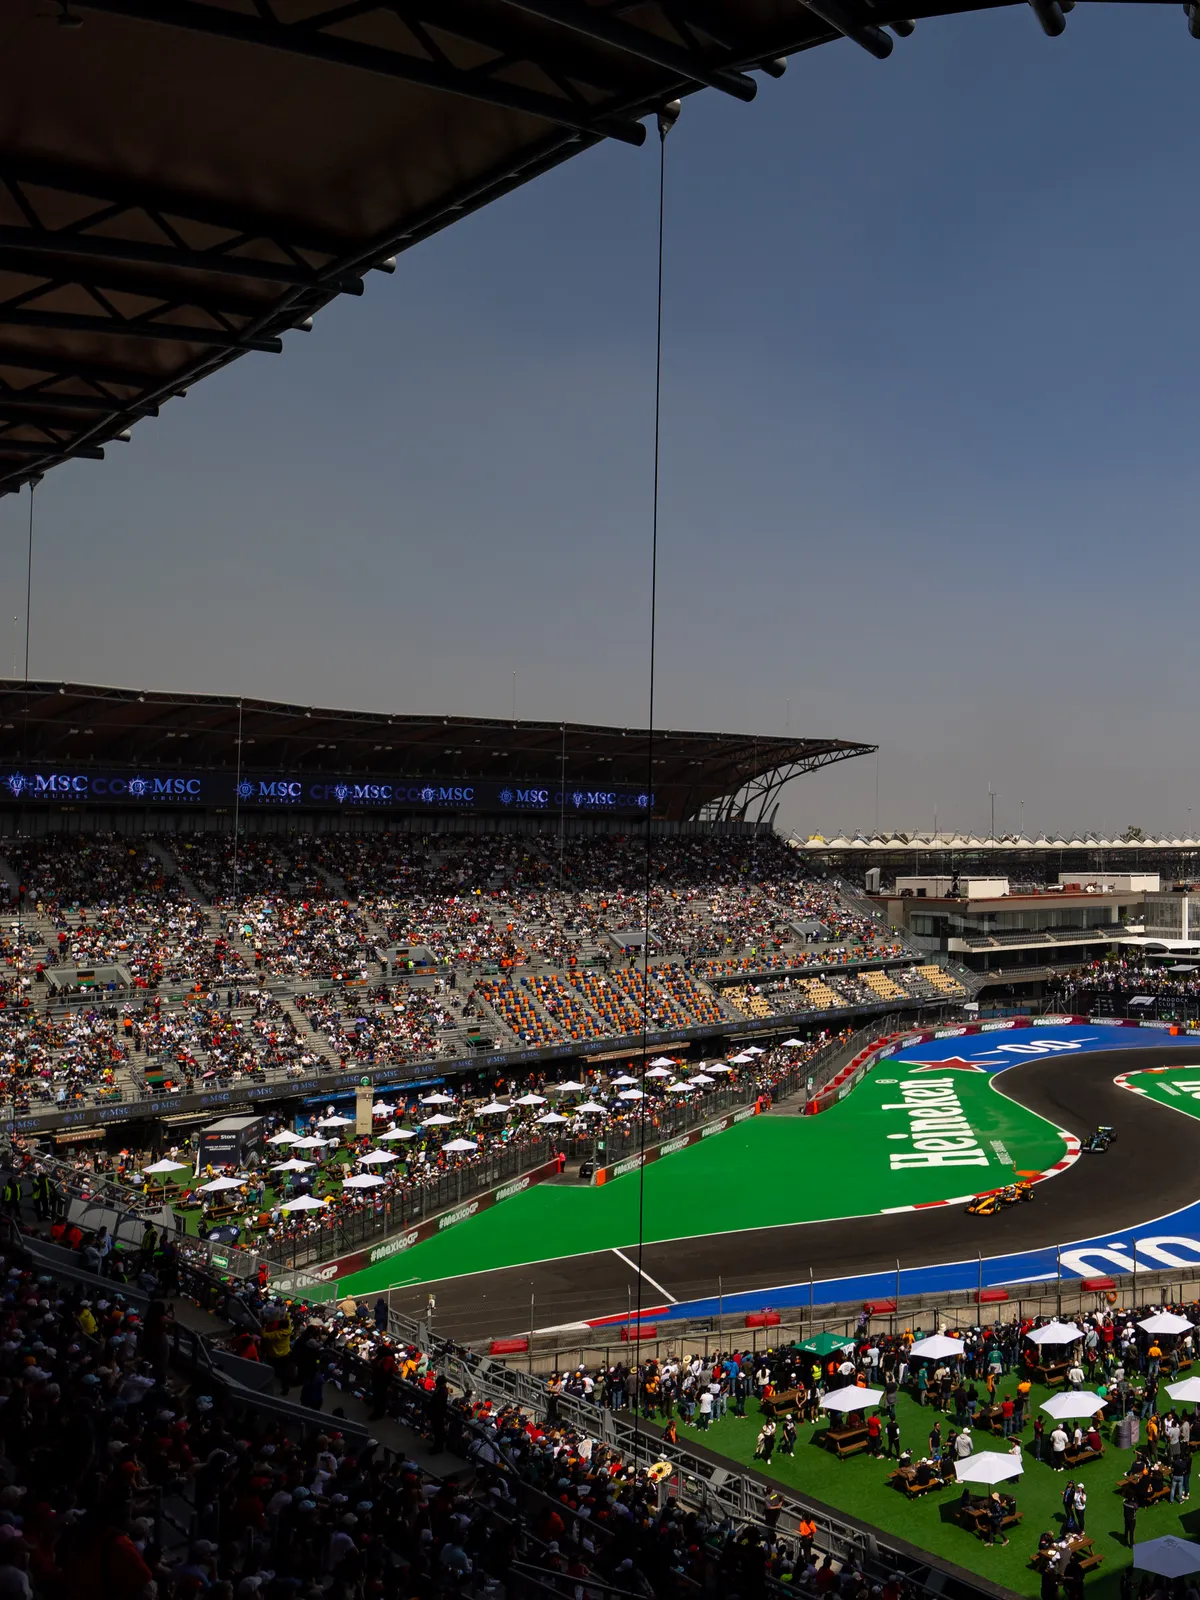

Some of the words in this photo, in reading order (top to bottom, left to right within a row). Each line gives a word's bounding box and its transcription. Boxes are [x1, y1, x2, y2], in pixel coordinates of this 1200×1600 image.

[34, 773, 88, 792] MSC
[153, 778, 201, 794] MSC
[259, 781, 303, 797] MSC
[354, 784, 392, 800] MSC
[440, 786, 475, 801] MSC
[516, 790, 550, 803] MSC
[586, 792, 617, 805] MSC
[882, 1077, 990, 1171] Heineken
